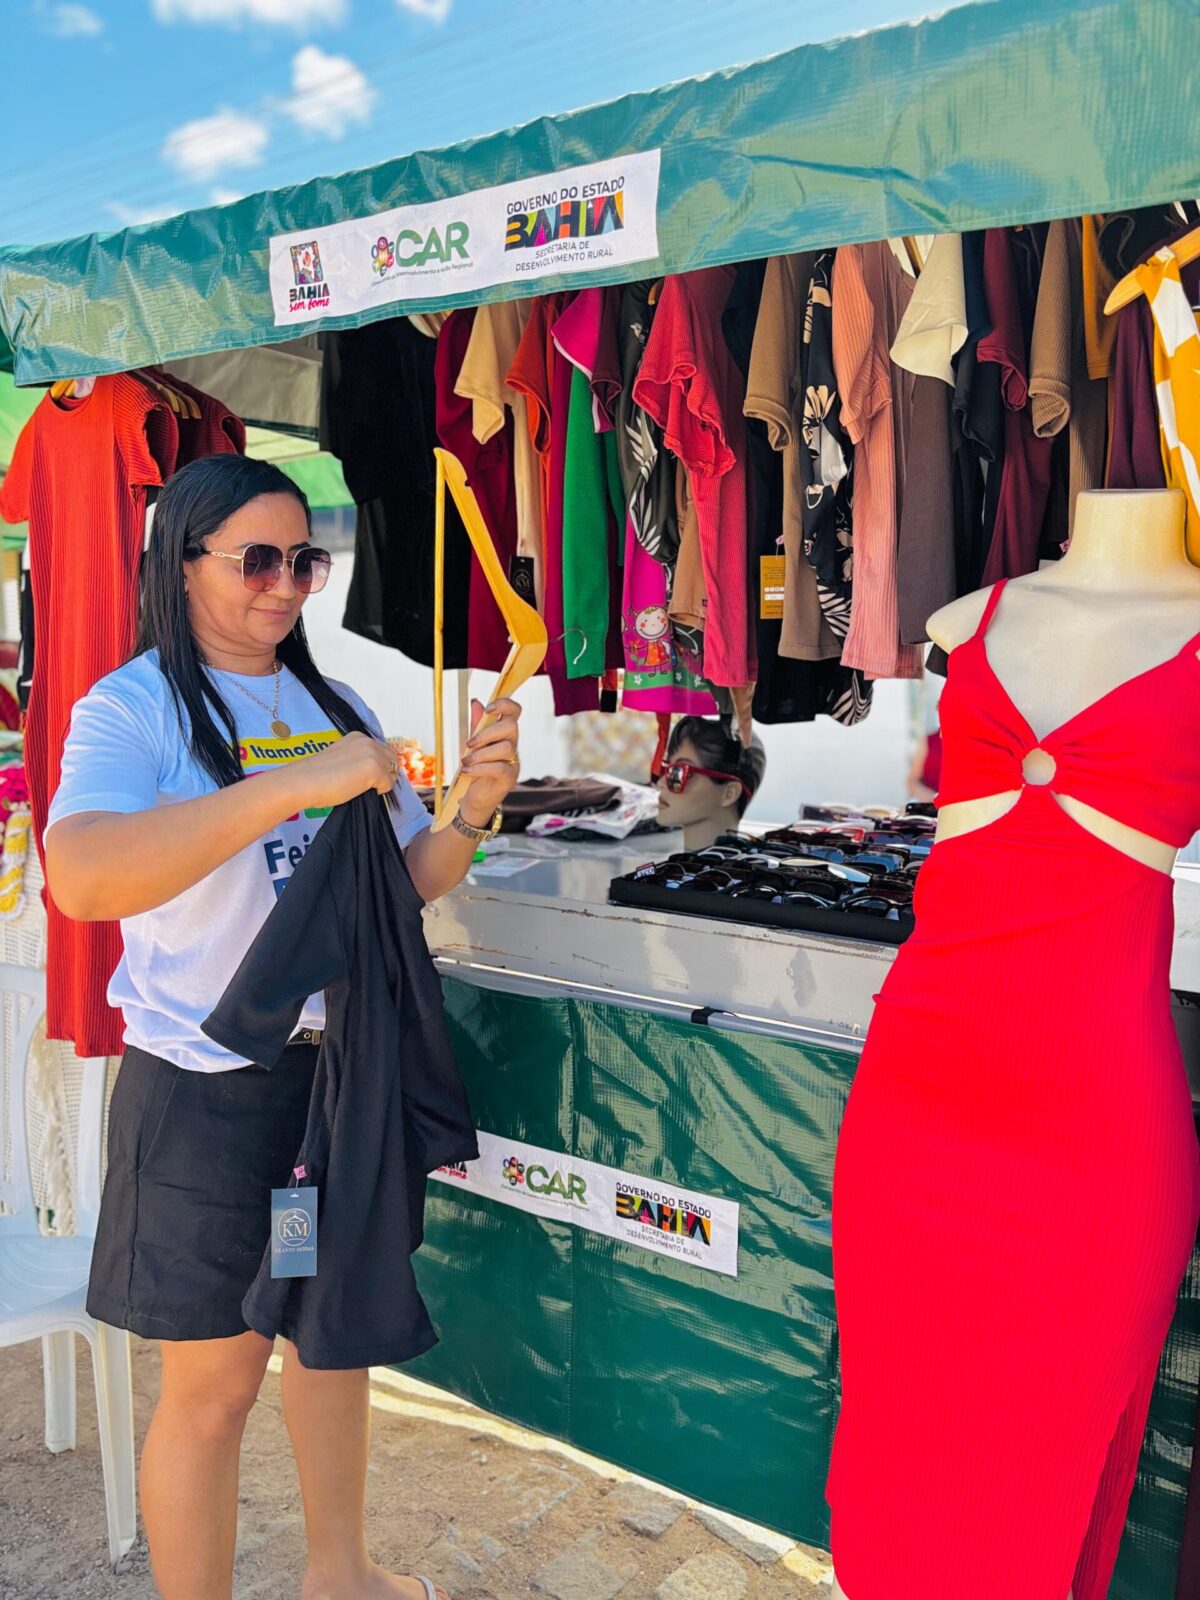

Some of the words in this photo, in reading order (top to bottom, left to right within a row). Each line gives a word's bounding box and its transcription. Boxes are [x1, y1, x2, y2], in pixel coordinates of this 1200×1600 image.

[507, 191, 558, 215] GOVERNO
[560, 186, 578, 200] DO
[582, 176, 625, 198] ESTADO
[504, 192, 624, 252] BAHIA
[396, 221, 470, 267] CAR
[535, 241, 576, 259] SECRETARIA
[579, 240, 590, 249] DE
[515, 252, 586, 272] DESENVOLVIMENTO
[587, 248, 614, 259] RURAL
[289, 283, 330, 302] BAHIA
[249, 739, 335, 758] Itamotin
[526, 1164, 588, 1205] CAR
[616, 1182, 660, 1202] GOVERNO
[661, 1195, 676, 1207] DO
[678, 1199, 712, 1218] ESTADO
[282, 1222, 308, 1237] KM
[616, 1192, 711, 1246] BAHIA
[641, 1225, 675, 1244] SECRETARIA
[676, 1237, 685, 1246] DE
